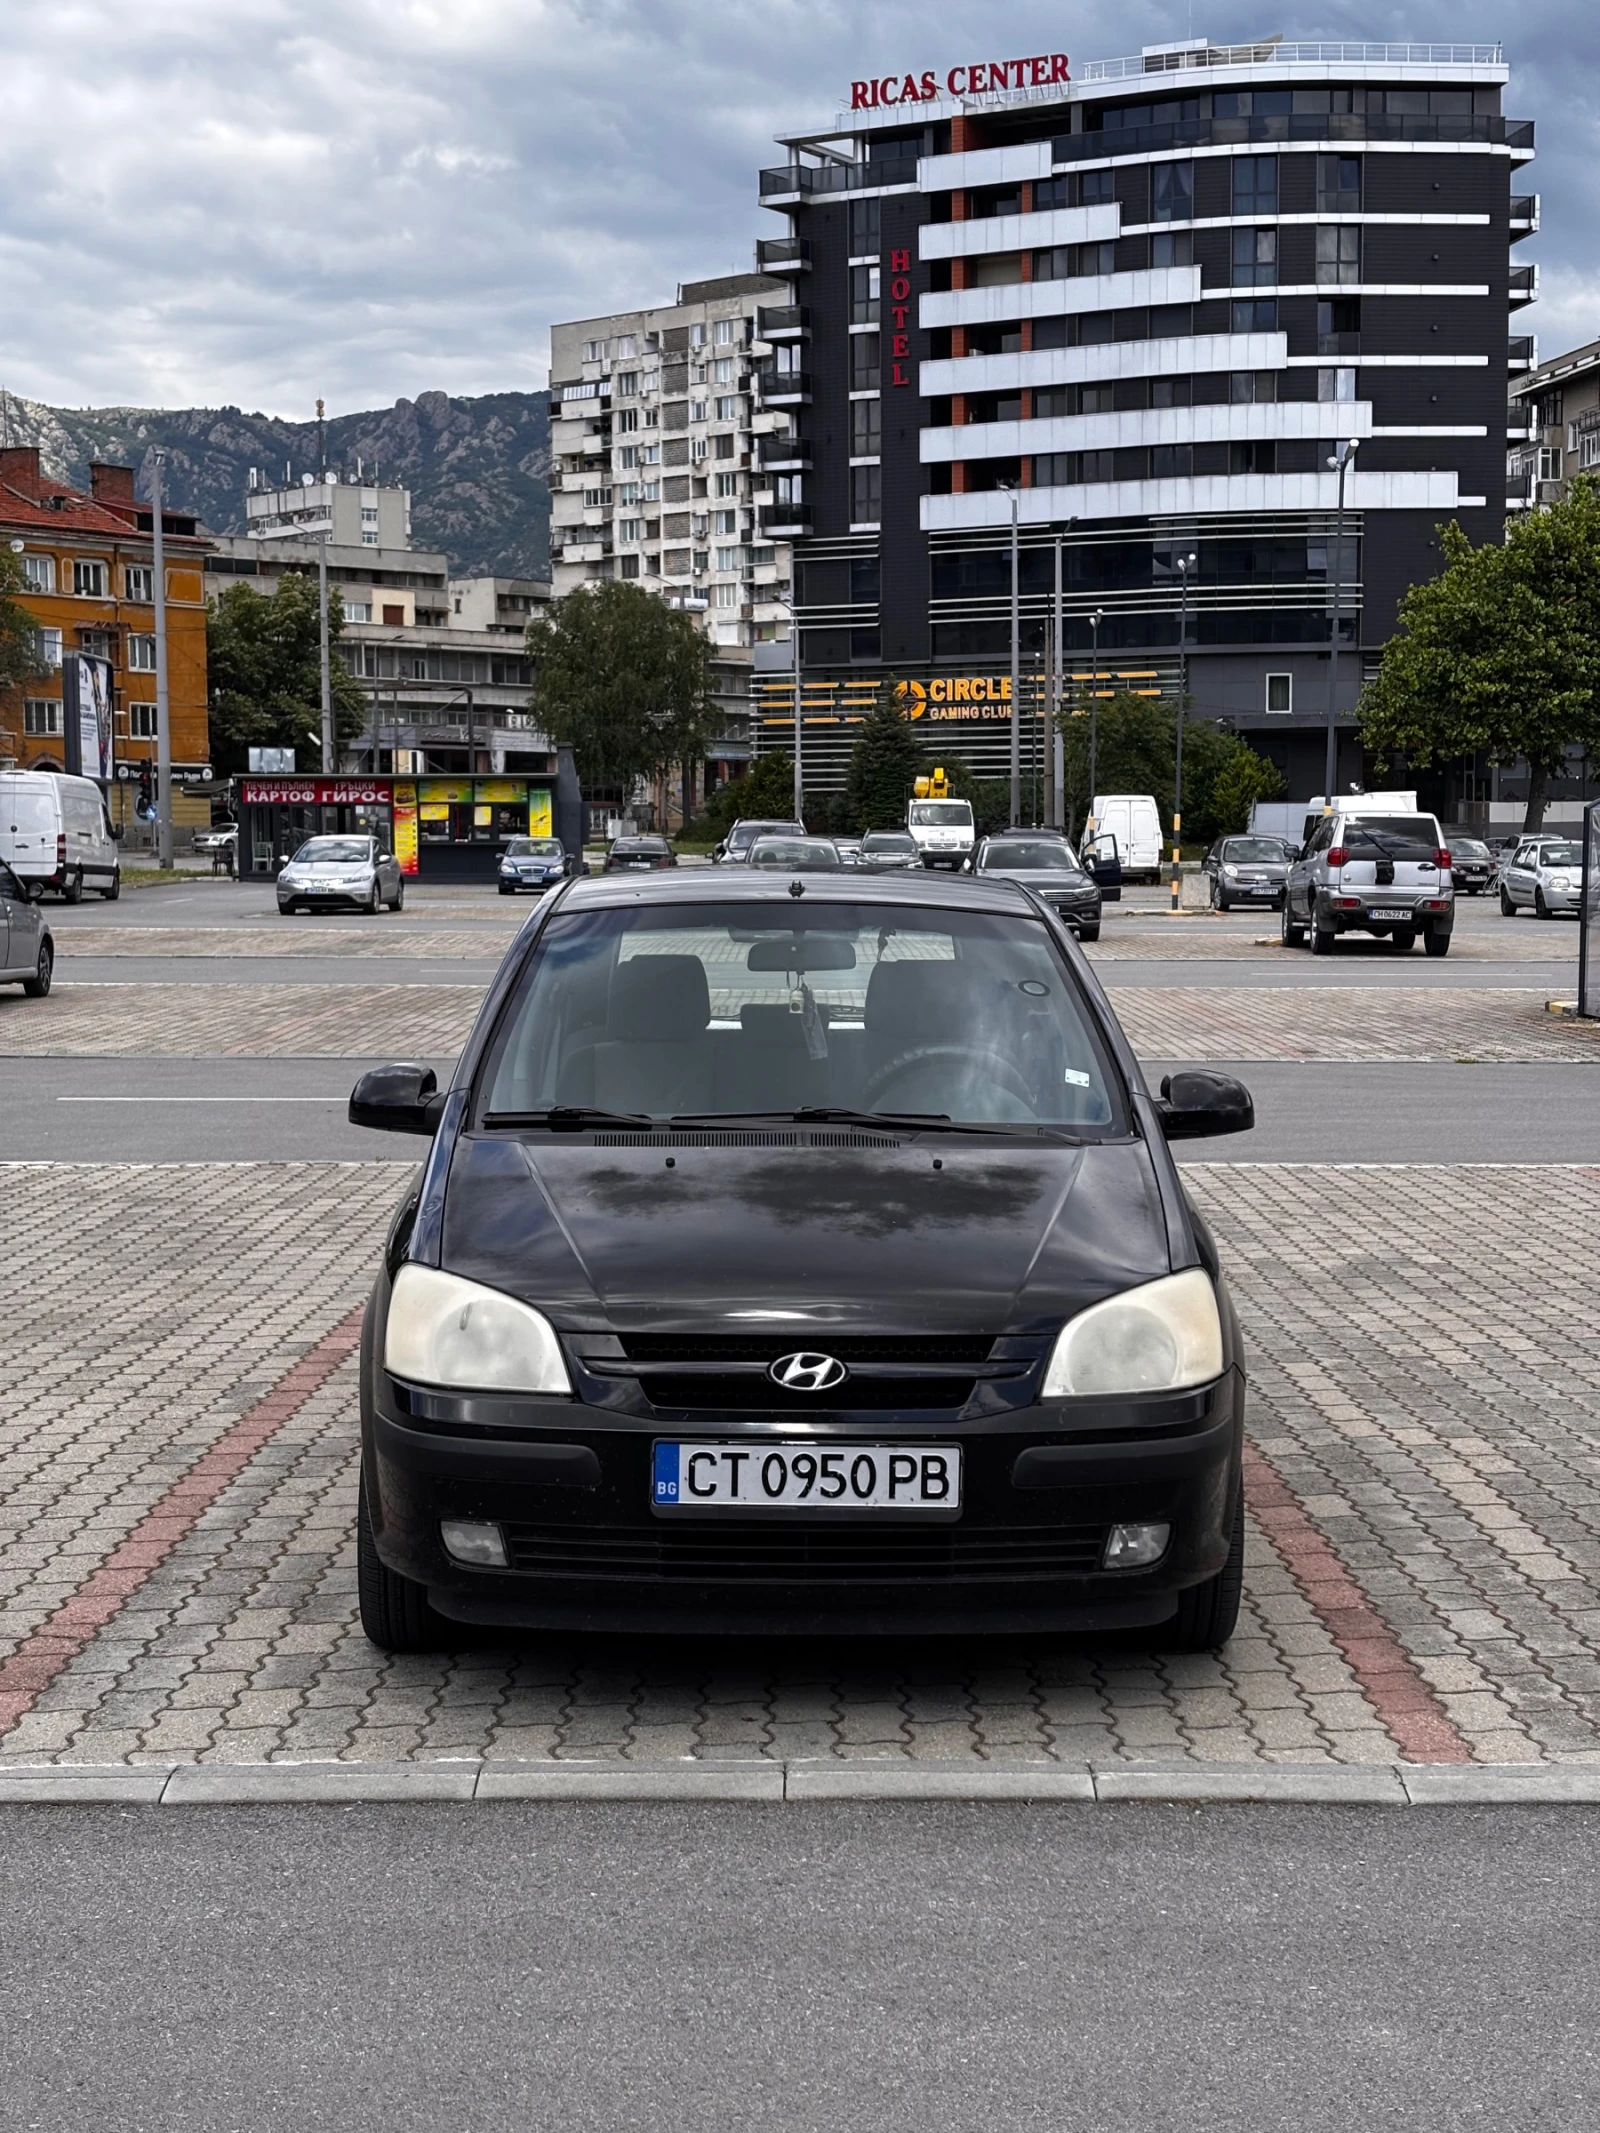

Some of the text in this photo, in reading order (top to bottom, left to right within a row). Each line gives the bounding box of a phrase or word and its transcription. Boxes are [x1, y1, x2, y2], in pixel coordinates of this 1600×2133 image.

[851, 54, 1071, 110] RICAS CENTER
[891, 249, 911, 386] HOTEL
[930, 677, 1012, 702] CIRCLE
[929, 706, 980, 720] GAMING
[247, 790, 316, 803] КАРТОФ
[321, 790, 390, 803] ГИРОС
[688, 1452, 950, 1500] CT 0950 PB
[657, 1481, 677, 1496] BG
